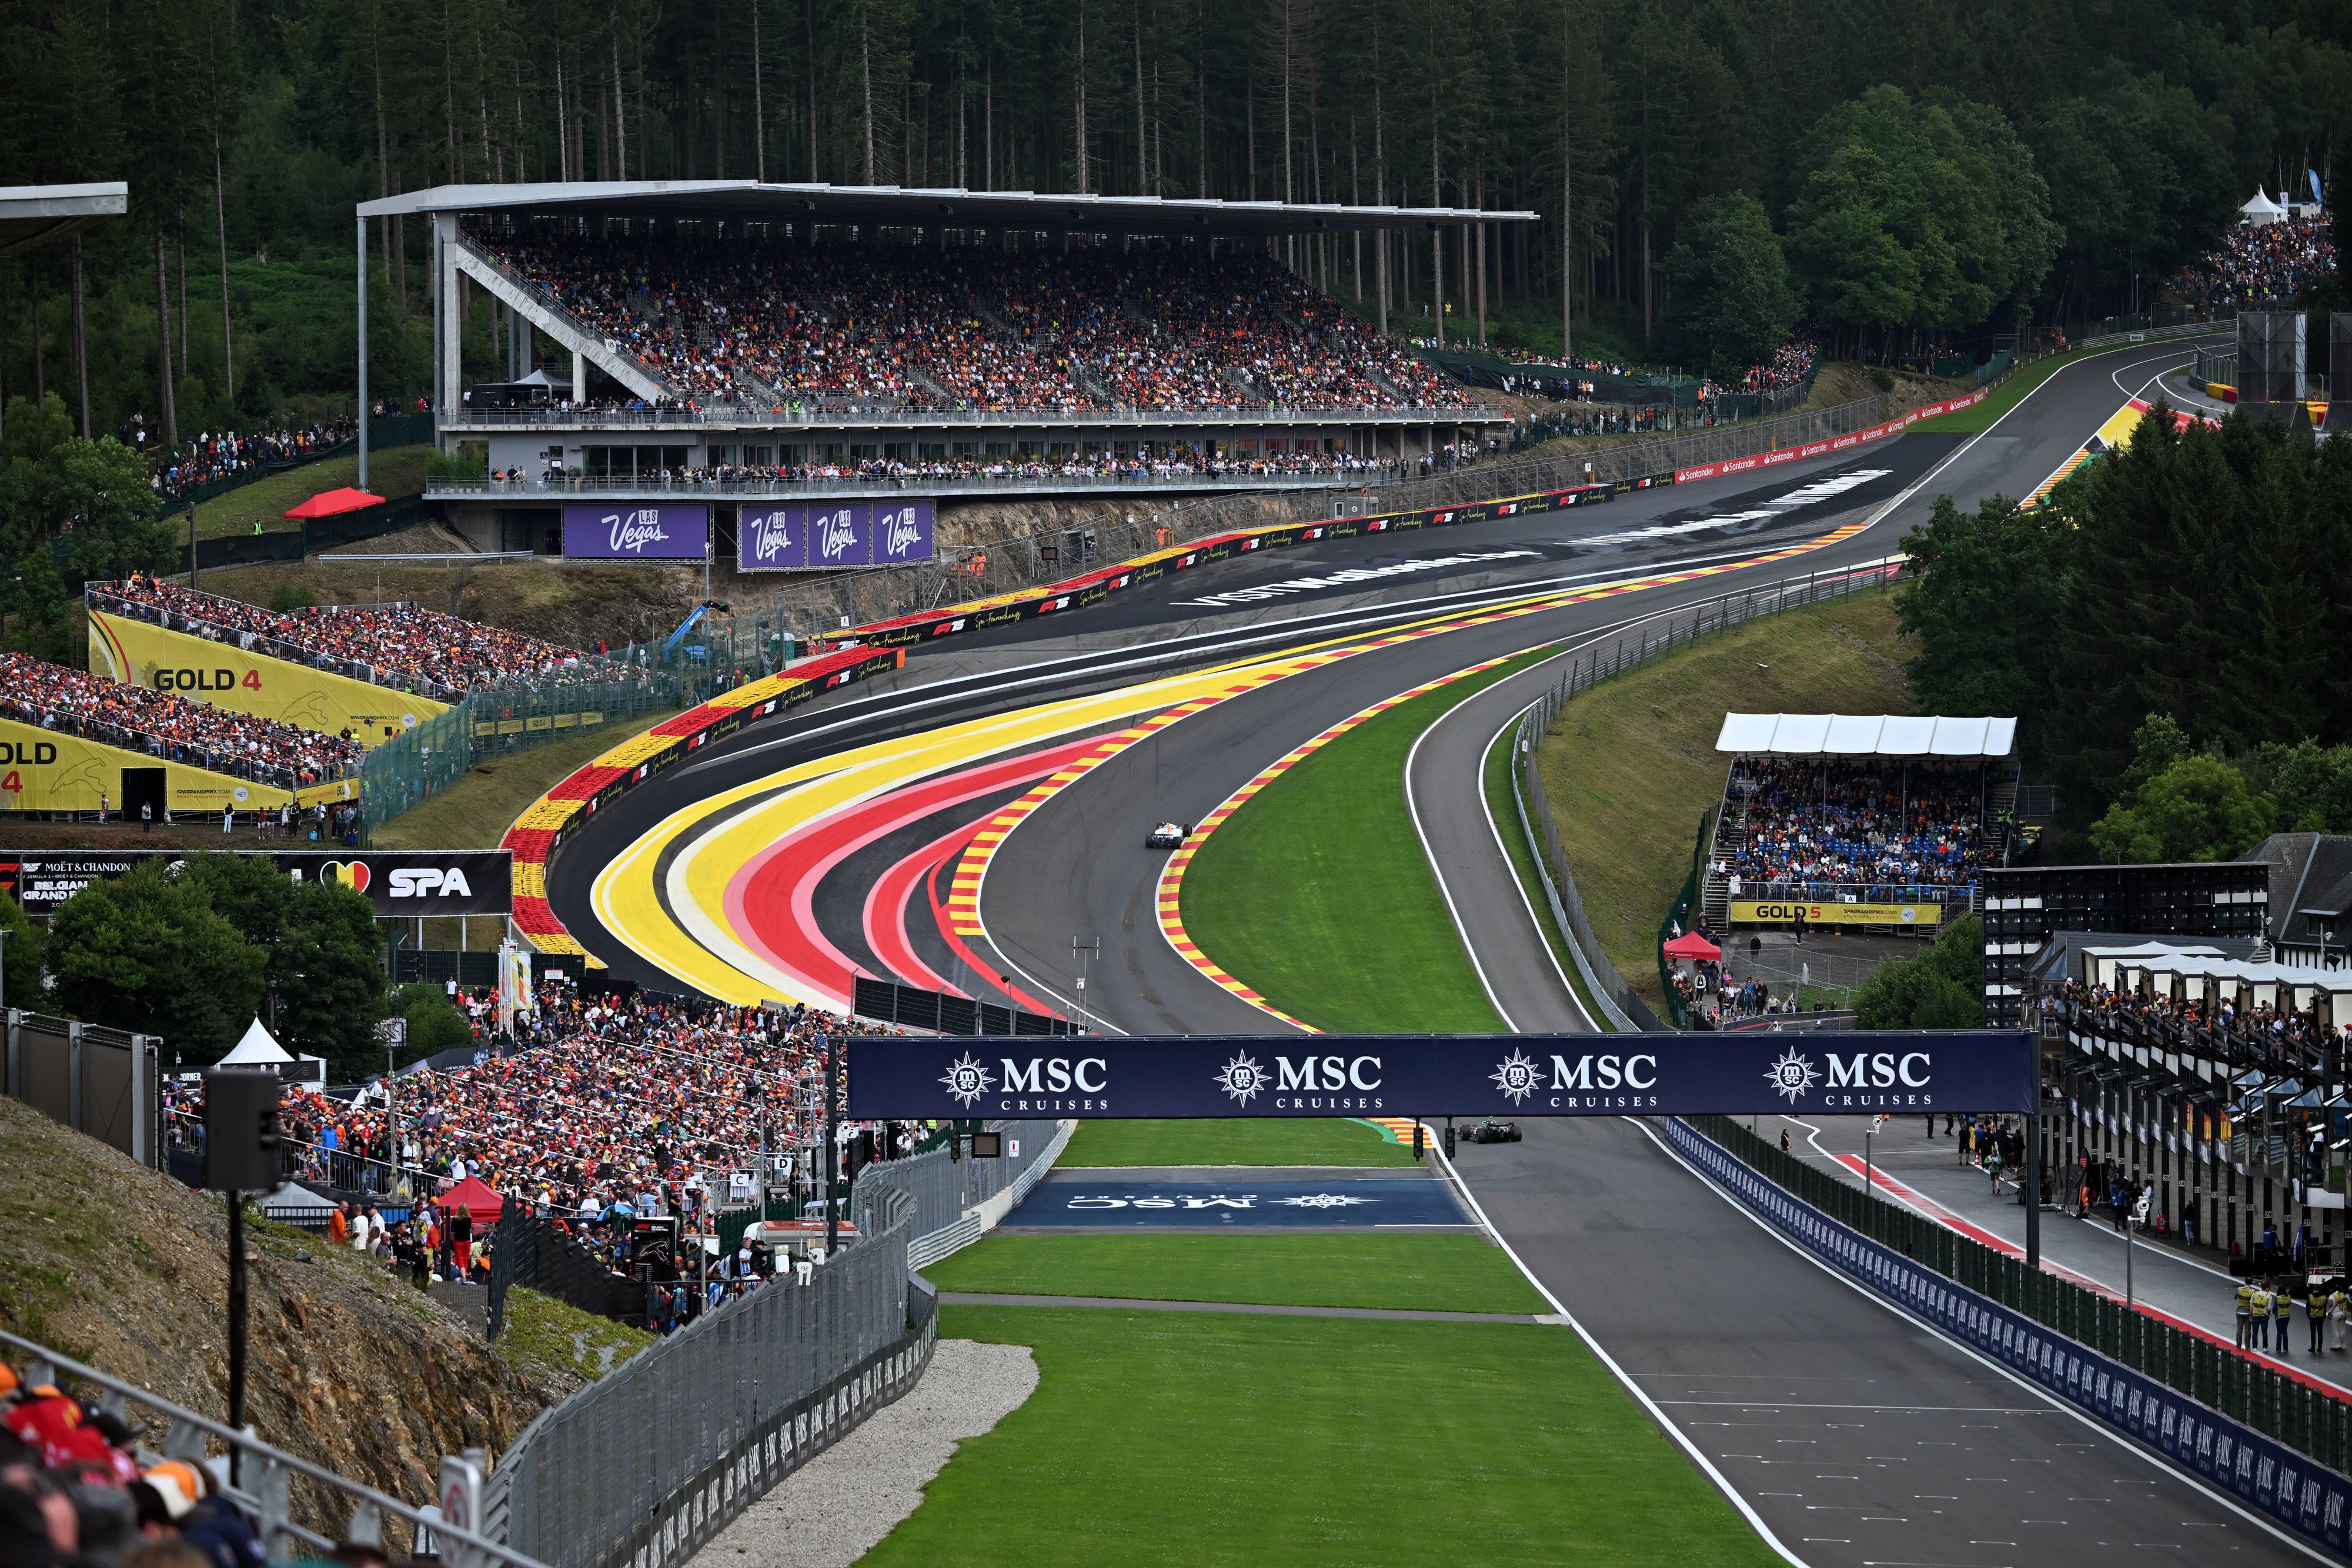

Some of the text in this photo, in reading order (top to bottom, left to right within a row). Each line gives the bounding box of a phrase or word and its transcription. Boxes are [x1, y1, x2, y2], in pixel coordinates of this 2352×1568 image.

[1925, 406, 1943, 416] Santander
[1866, 429, 1883, 439] Santander
[1838, 436, 1857, 447] Santander
[1806, 443, 1827, 455] Santander
[1770, 452, 1793, 462] Santander
[1729, 460, 1755, 471] Santander
[1686, 468, 1713, 480] Santander
[641, 510, 656, 523] LAS
[774, 513, 784, 527] LAS
[840, 511, 850, 525] LAS
[904, 509, 914, 523] LAS
[602, 513, 669, 553] Vegas
[751, 515, 791, 562] Vegas
[817, 514, 857, 560] Vegas
[882, 511, 921, 557] Vegas
[154, 669, 262, 691] GOLD 4
[1, 771, 23, 793] 4
[46, 861, 131, 871] MOËT & CHANDON
[34, 881, 88, 890] BELGIAN
[389, 868, 472, 897] SPA
[24, 891, 67, 900] GRAND
[1756, 905, 1820, 918] GOLD 5
[1000, 1058, 1107, 1092] MSC
[1275, 1057, 1382, 1090] MSC
[1550, 1055, 1657, 1089] MSC
[1825, 1054, 1932, 1087] MSC
[1001, 1100, 1107, 1110] CRUISES
[1276, 1098, 1382, 1108] CRUISES
[1551, 1097, 1657, 1106] CRUISES
[1826, 1095, 1932, 1105] CRUISES
[779, 1158, 788, 1168] D
[736, 1176, 743, 1185] C
[1067, 1199, 1257, 1209] MSC
[2183, 1415, 2194, 1446] MSC
[2201, 1425, 2213, 1456] MSC
[2220, 1435, 2232, 1467] MSC
[2241, 1445, 2253, 1479] MSC
[2261, 1456, 2274, 1490] MSC
[2283, 1467, 2297, 1502] MSC
[2306, 1479, 2320, 1514] MSC
[2331, 1491, 2344, 1528] MSC
